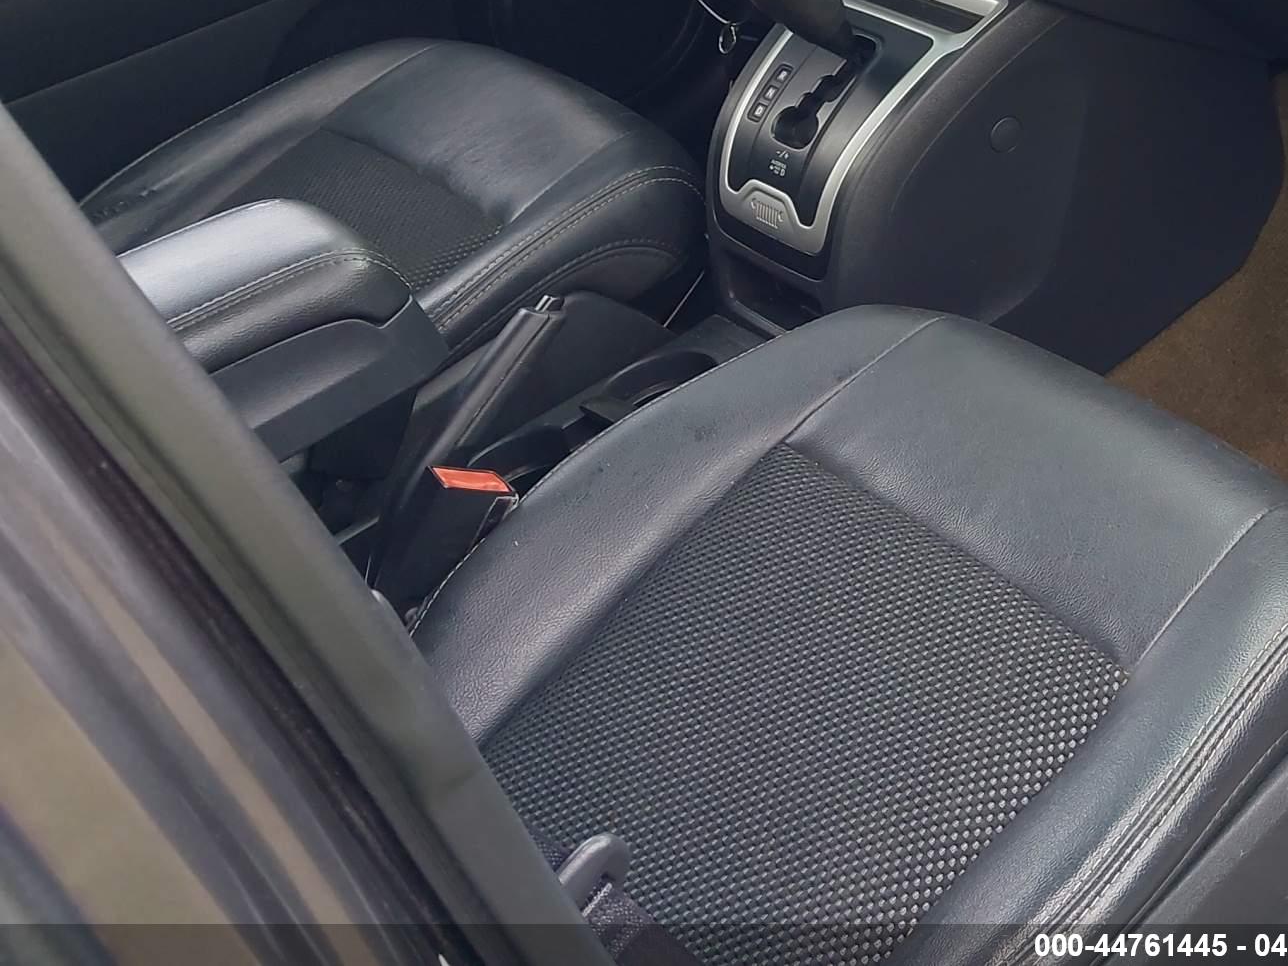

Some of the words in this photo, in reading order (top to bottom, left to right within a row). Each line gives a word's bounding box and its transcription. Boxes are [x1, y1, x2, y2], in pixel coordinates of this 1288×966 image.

[776, 70, 788, 81] R
[764, 88, 776, 100] N
[754, 106, 765, 117] D
